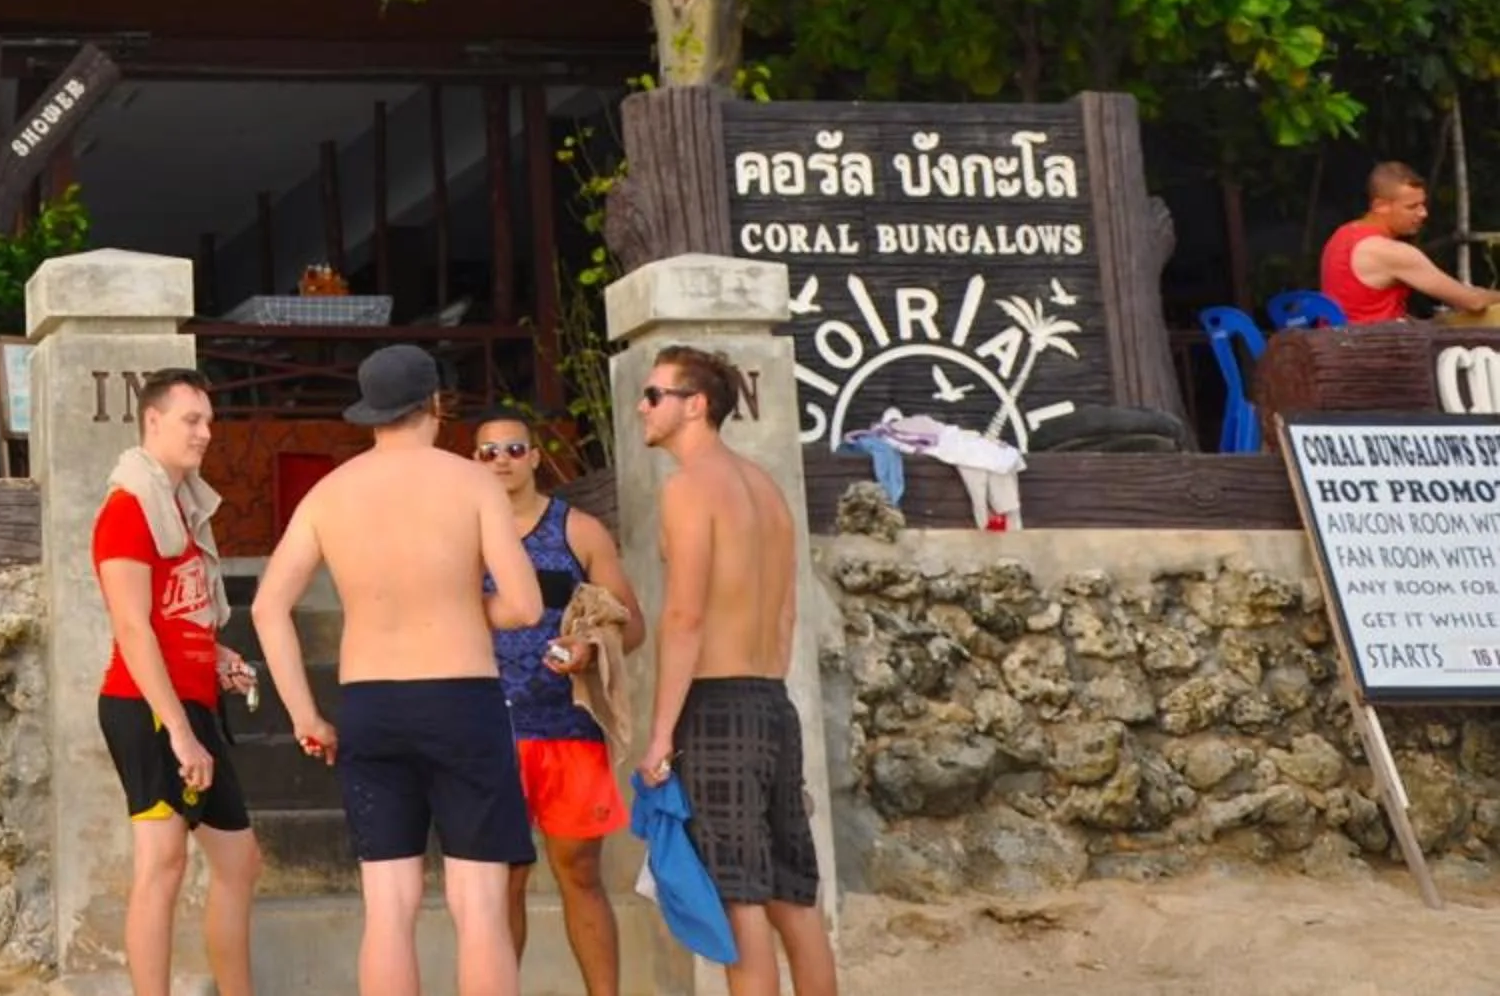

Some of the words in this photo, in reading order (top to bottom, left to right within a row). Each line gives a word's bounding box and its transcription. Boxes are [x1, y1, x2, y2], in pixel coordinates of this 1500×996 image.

[11, 79, 85, 157] SHOWER
[735, 130, 873, 196] คอรัล
[894, 131, 1078, 198] บังกะโล
[741, 224, 858, 253] CORAL
[877, 225, 1083, 254] BUNGALOWS
[1302, 435, 1364, 466] CORAL
[1363, 435, 1476, 466] BUNGALOWS
[1317, 480, 1378, 503] HOT
[1387, 480, 1500, 503] PROMO
[1408, 513, 1470, 534] ROOM
[1336, 546, 1375, 567] FAN
[1378, 546, 1440, 568] ROOM
[1441, 546, 1496, 568] WITH
[1348, 580, 1386, 594] ANY
[1394, 580, 1456, 594] ROOM
[1460, 580, 1498, 594] FOR
[1362, 612, 1396, 628] GET
[1405, 612, 1422, 627] IT
[1430, 612, 1499, 628] WHILE
[1366, 644, 1444, 668] STARTS
